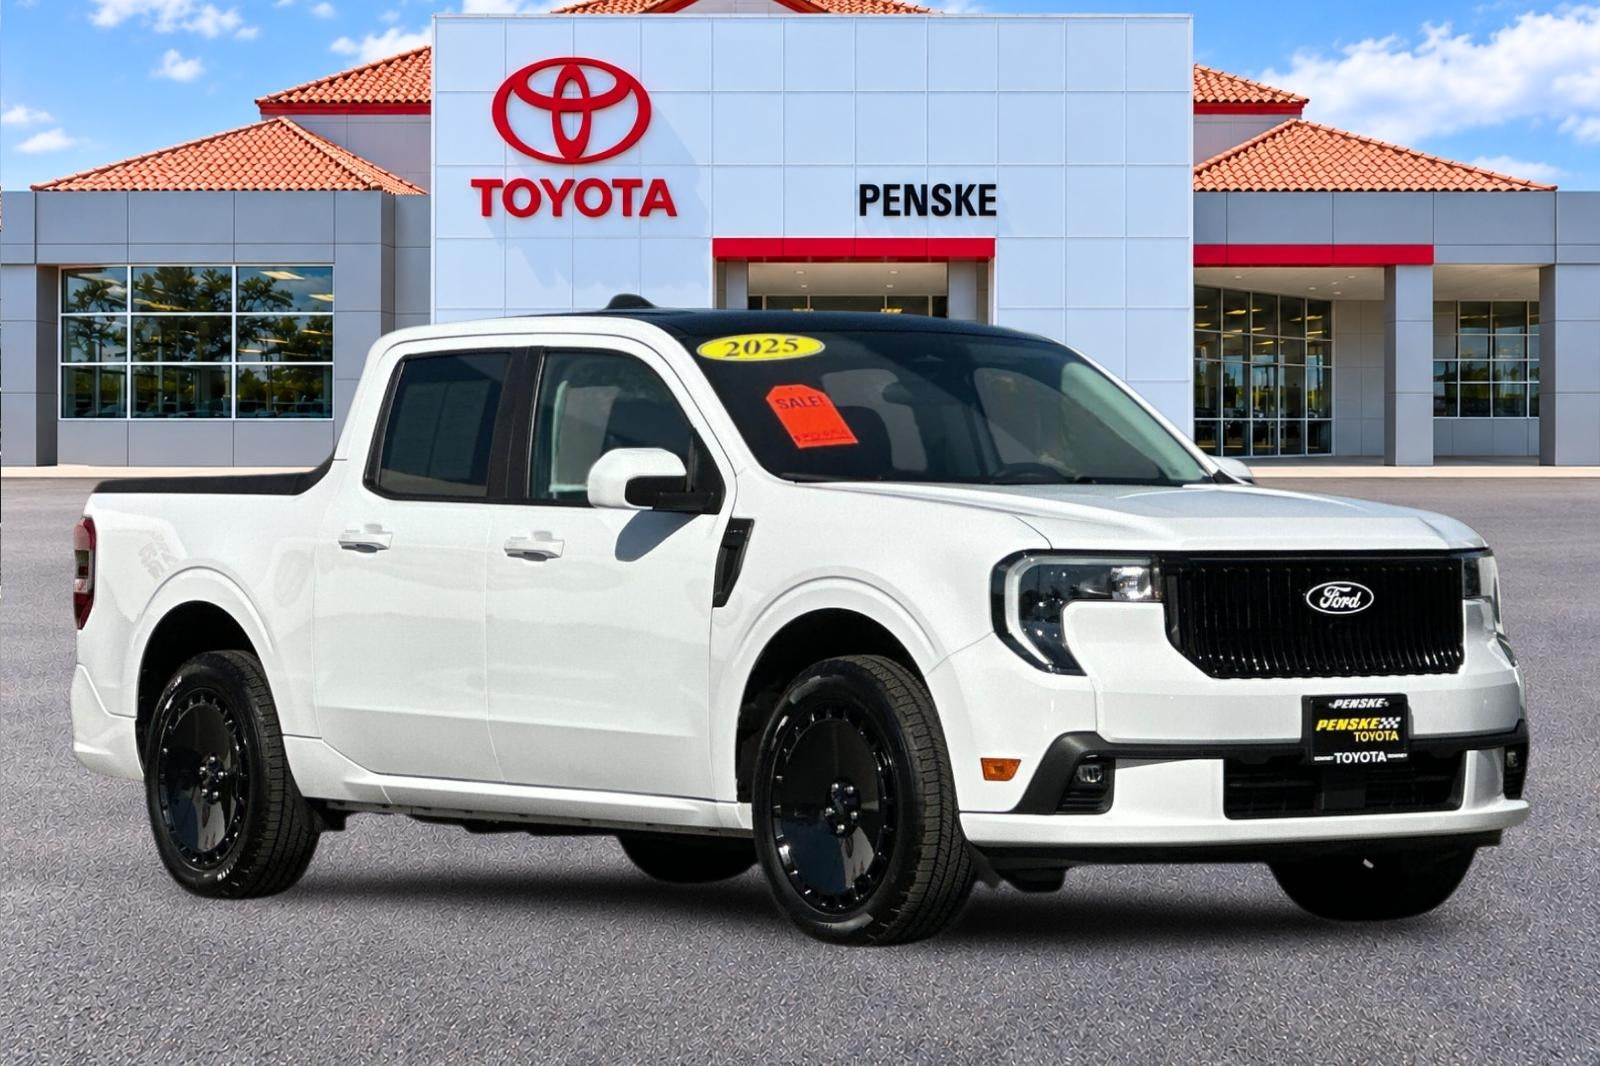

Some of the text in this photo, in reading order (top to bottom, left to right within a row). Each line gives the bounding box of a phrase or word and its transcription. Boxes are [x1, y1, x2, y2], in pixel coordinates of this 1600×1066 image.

[471, 178, 678, 218] TOYOTA
[858, 183, 998, 217] PENSKE
[724, 338, 799, 357] 2025
[775, 395, 824, 410] SALE!
[1319, 585, 1362, 609] Ford
[1333, 698, 1385, 709] PENSKE
[1316, 718, 1381, 731] PENSKE
[1353, 731, 1399, 742] TOYOTA
[1334, 751, 1387, 764] TOYOTA
